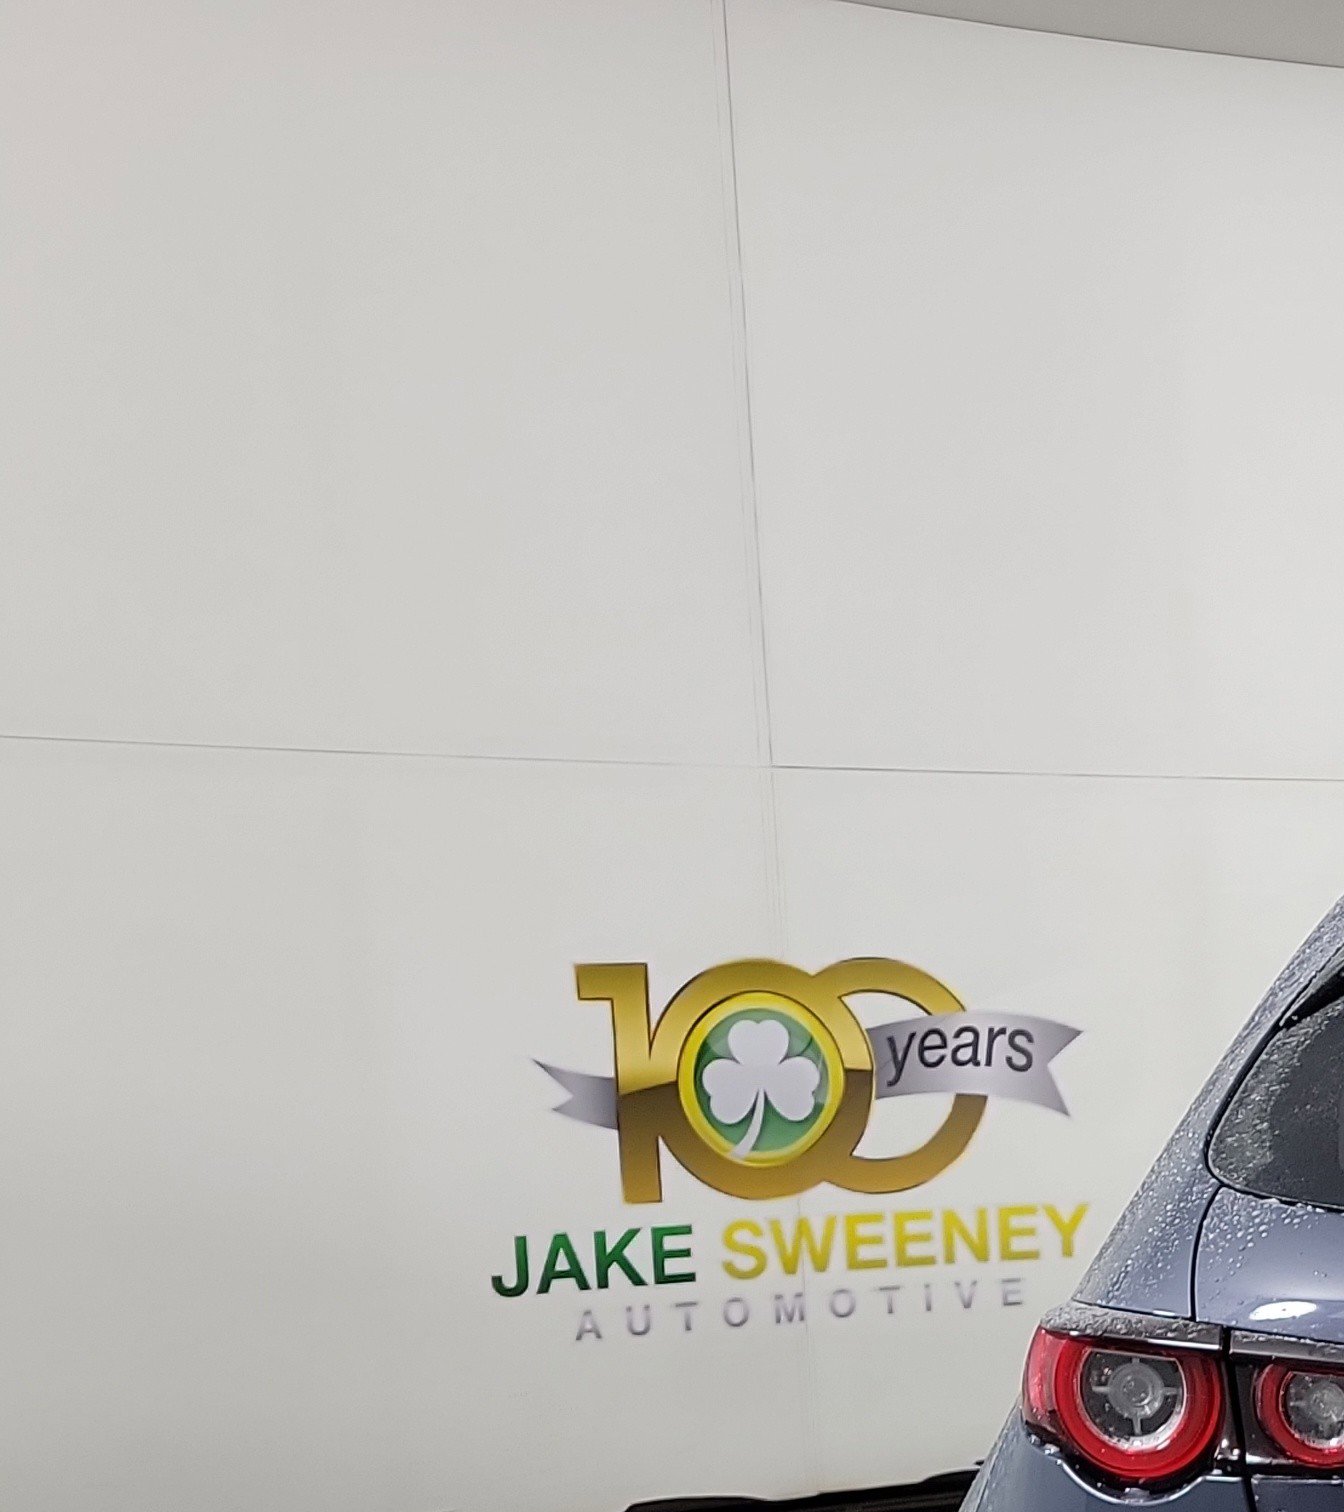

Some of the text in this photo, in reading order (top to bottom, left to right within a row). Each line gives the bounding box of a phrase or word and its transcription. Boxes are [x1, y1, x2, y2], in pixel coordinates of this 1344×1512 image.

[573, 956, 1036, 1204] 100 years
[490, 1203, 1091, 1298] JAKE SWEENEY
[575, 1278, 1026, 1343] AUTOMOTIVE
